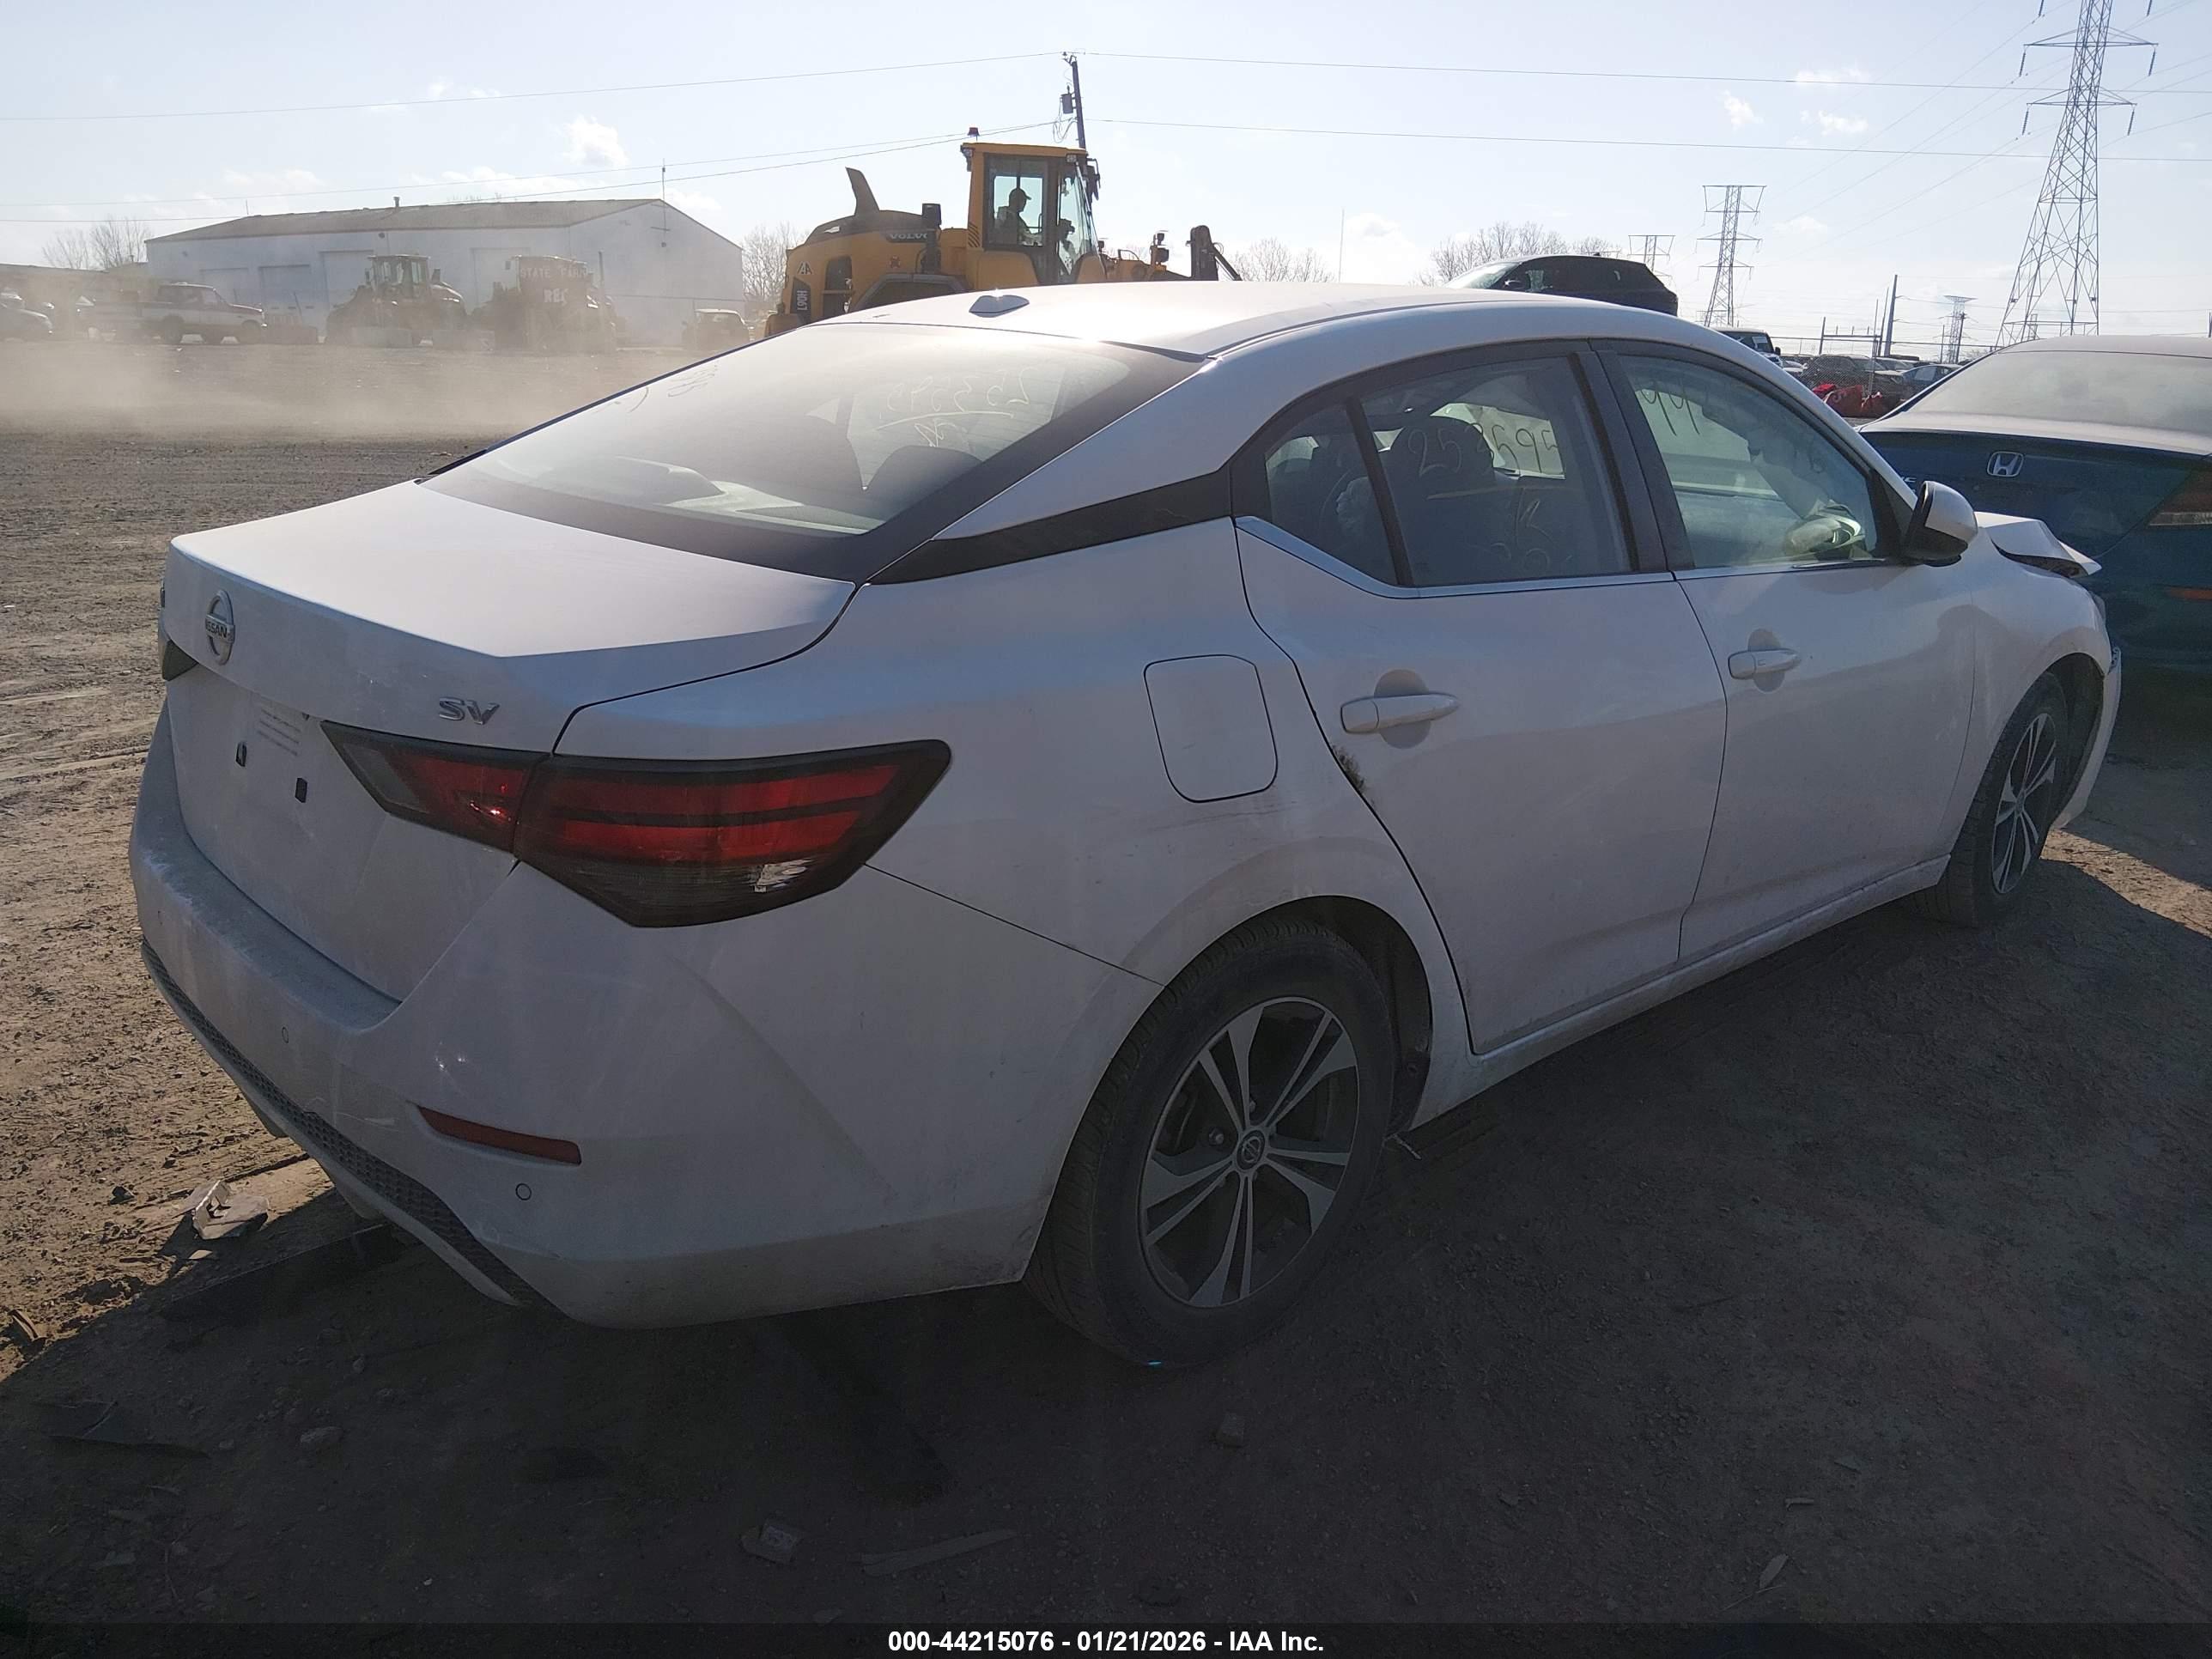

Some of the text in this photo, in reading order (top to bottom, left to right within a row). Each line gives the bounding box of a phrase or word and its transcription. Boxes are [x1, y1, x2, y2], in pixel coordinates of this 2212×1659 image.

[796, 290, 808, 311] L90H
[206, 620, 228, 638] SSAN
[439, 696, 500, 725] SV
